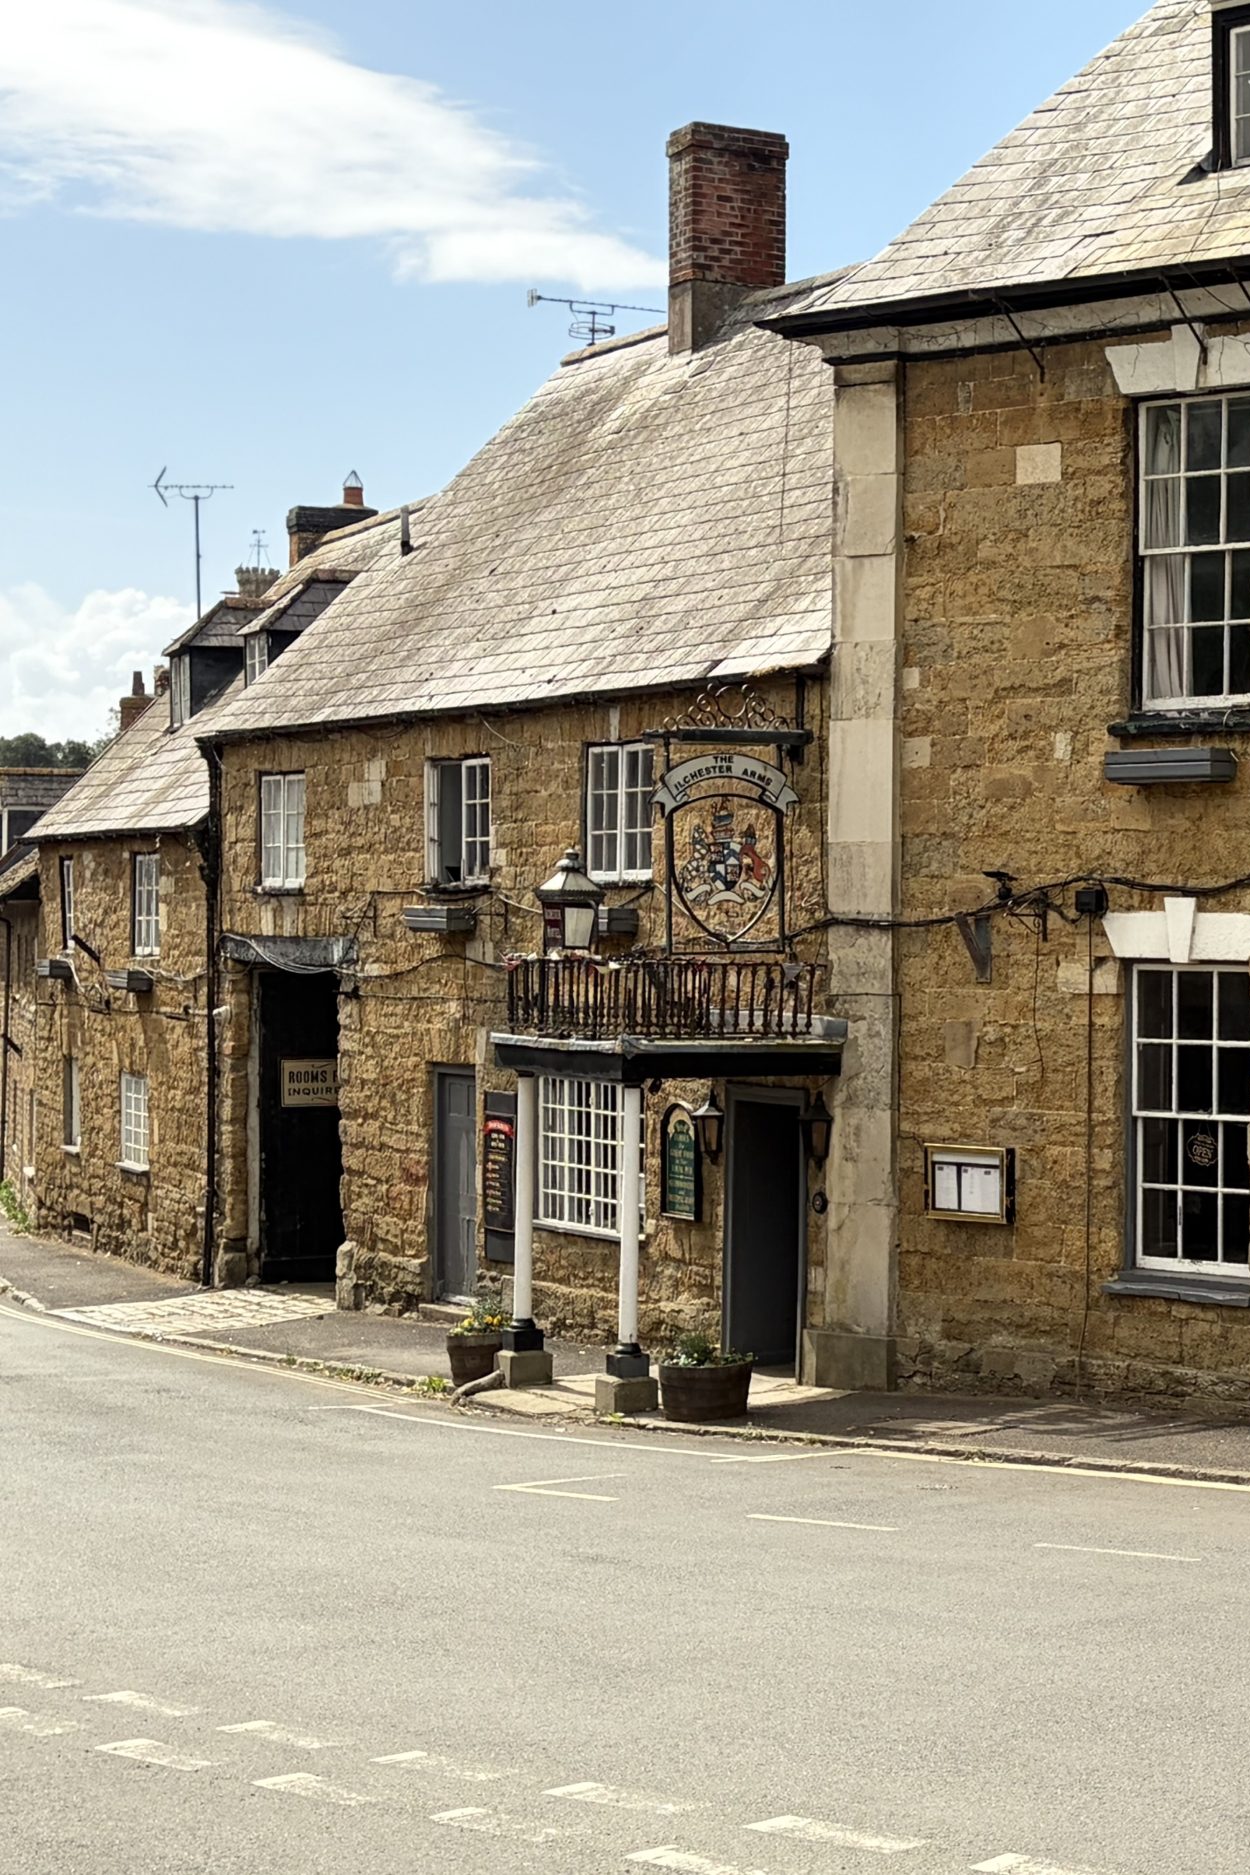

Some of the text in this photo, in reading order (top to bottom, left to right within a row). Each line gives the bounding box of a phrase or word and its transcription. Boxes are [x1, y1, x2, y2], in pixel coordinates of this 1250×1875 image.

[712, 755, 734, 764] THE
[674, 764, 773, 791] ILCHESTER ARMS
[288, 1070, 328, 1084] ROOMS
